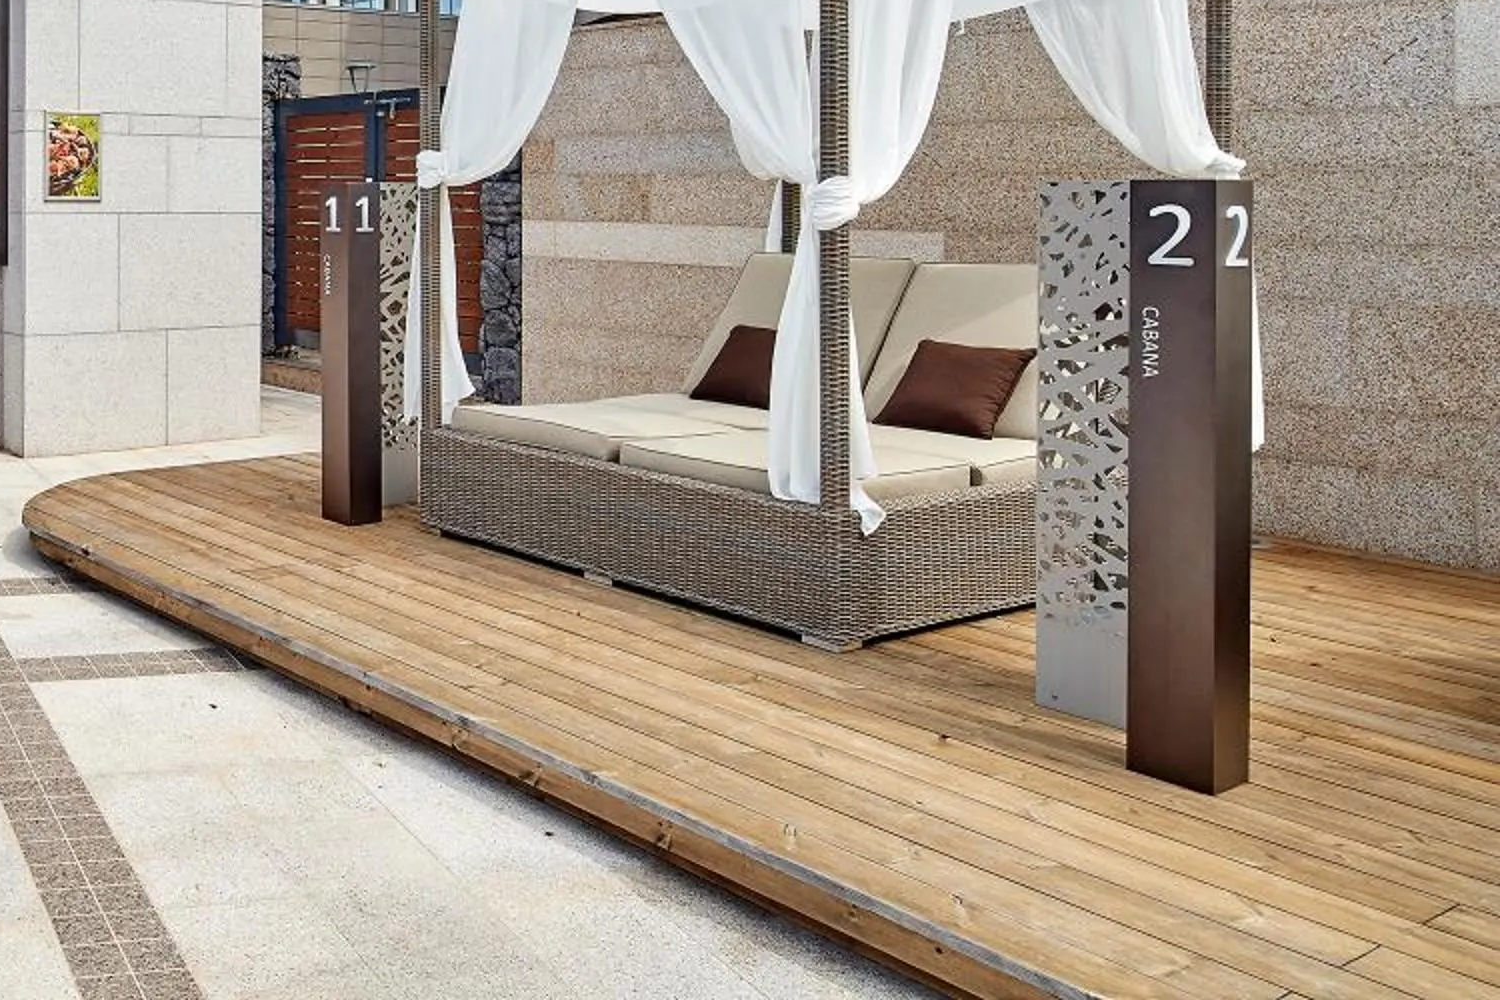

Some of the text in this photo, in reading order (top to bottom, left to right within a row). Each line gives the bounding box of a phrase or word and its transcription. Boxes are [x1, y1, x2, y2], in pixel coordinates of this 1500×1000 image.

[325, 195, 341, 233] 1
[355, 195, 376, 233] 1
[1147, 203, 1195, 267] 2
[1224, 205, 1249, 267] 2
[1141, 305, 1160, 378] CABANA
